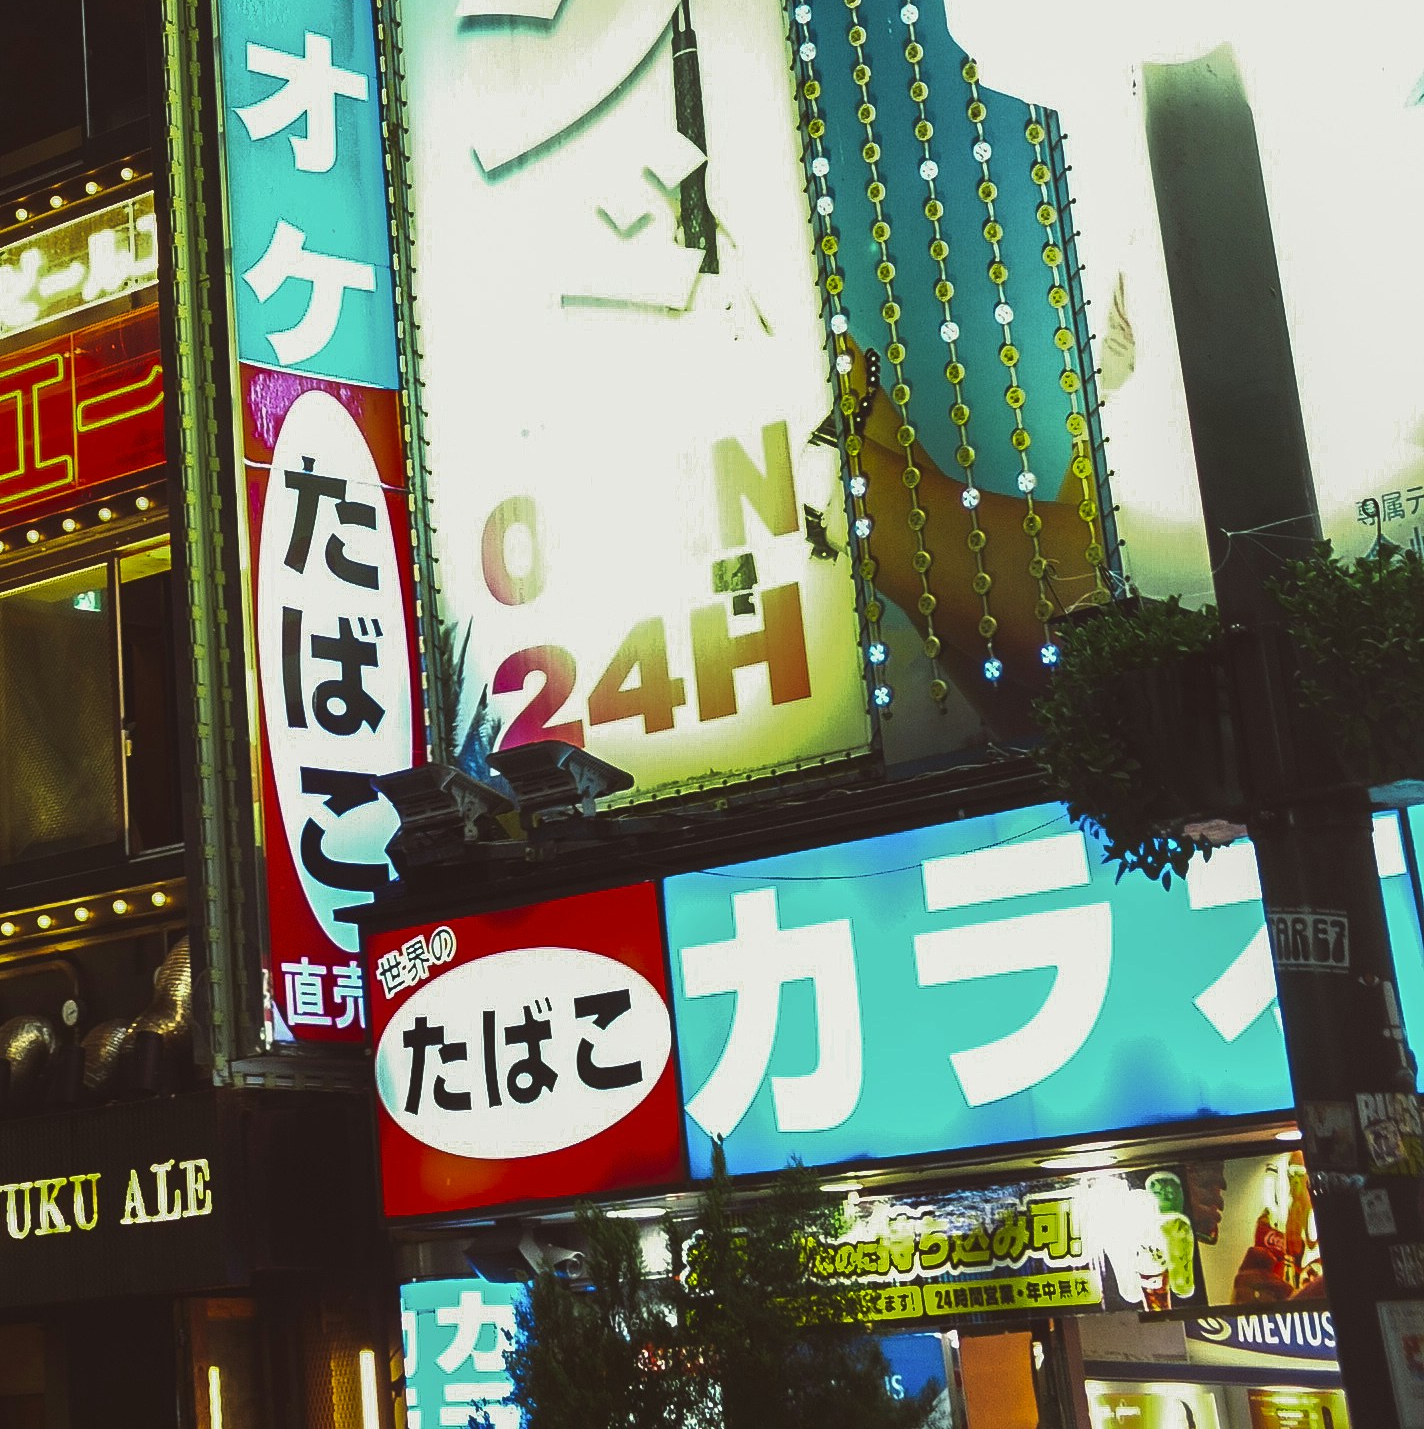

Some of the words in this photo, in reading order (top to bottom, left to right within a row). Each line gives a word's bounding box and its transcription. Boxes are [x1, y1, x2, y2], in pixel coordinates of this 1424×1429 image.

[481, 420, 801, 606] ON
[282, 455, 391, 896] たばこ
[492, 582, 812, 752] 24H
[377, 926, 457, 1000] 世界の
[402, 988, 644, 1116] たばこ
[119, 1158, 213, 1225] ALE
[1237, 1310, 1336, 1348] MEVIUS
